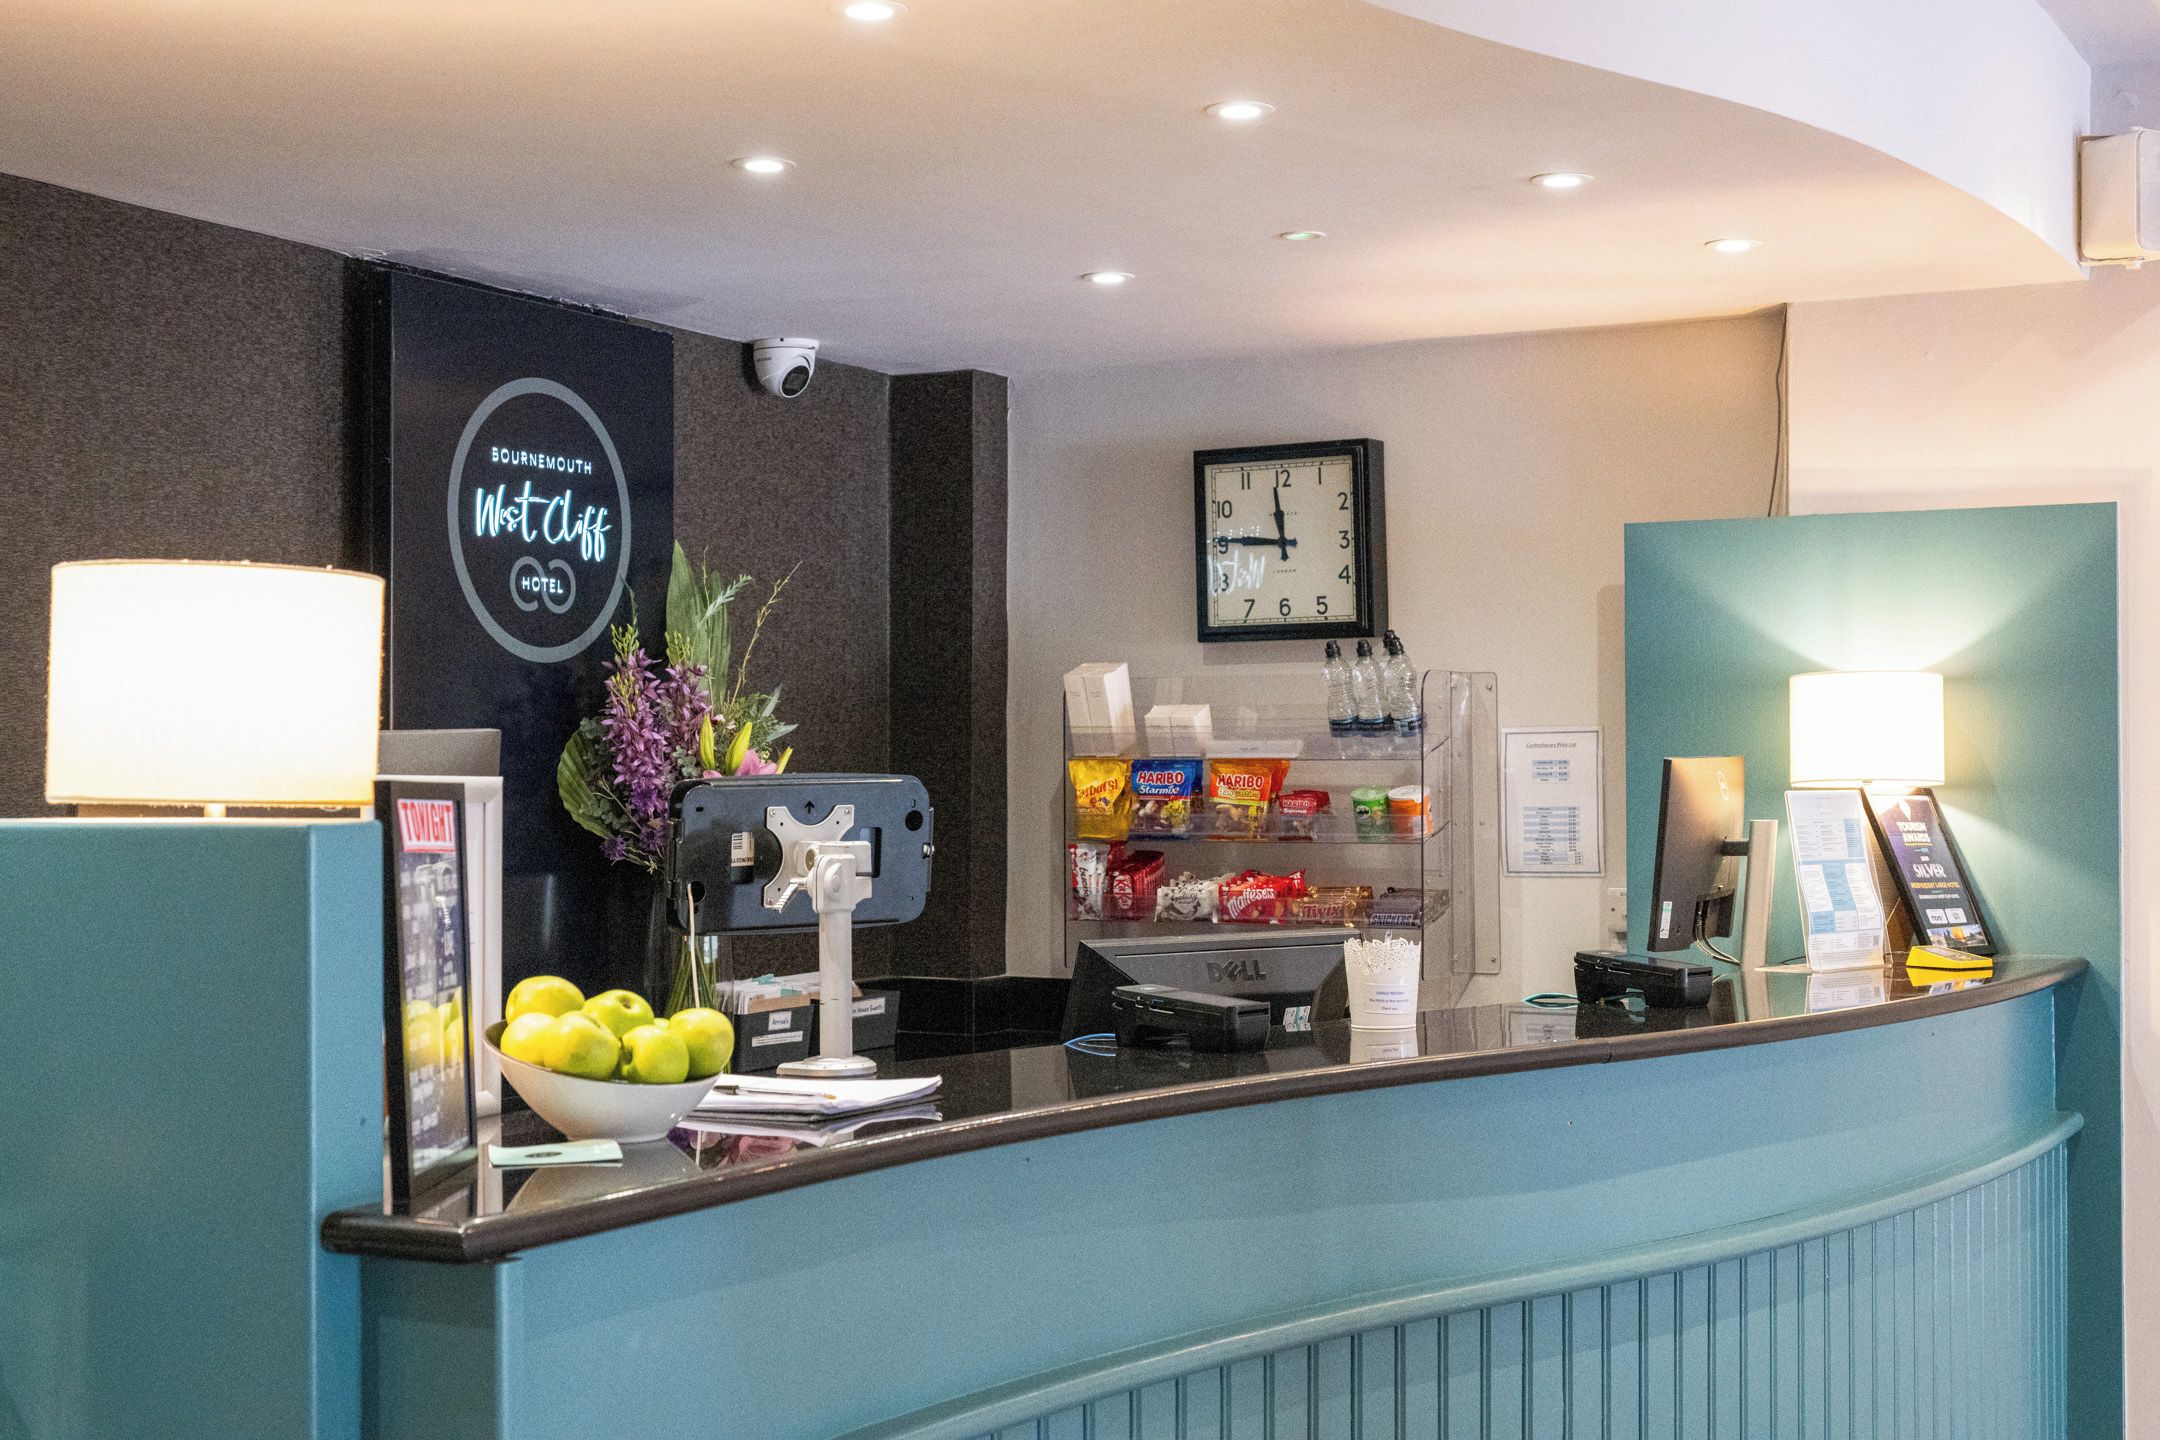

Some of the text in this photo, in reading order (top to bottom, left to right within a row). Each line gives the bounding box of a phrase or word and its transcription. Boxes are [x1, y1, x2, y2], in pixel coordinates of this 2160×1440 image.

[492, 447, 592, 475] BOURNEMOUTH
[1241, 472, 1252, 490] 11
[1274, 469, 1292, 488] 12
[1317, 467, 1322, 485] 1
[1217, 500, 1233, 518] 10
[1337, 492, 1349, 511] 2
[476, 480, 612, 562] West Cliff
[1217, 535, 1229, 555] 9
[1339, 530, 1351, 549] 3
[1338, 565, 1352, 584] 4
[521, 576, 564, 594] HOTEL
[1243, 599, 1256, 619] 7
[1279, 598, 1292, 617] 6
[1316, 596, 1329, 615] 5
[1136, 771, 1185, 786] HARIBO
[1216, 773, 1265, 789] HARIBO
[1138, 785, 1177, 795] Starmix
[1281, 798, 1312, 810] HARIBO
[402, 802, 452, 842] TONIGHT
[1903, 833, 1930, 842] AWARDS
[1912, 863, 1947, 878] SILVER
[1078, 867, 1090, 898] bueno
[1226, 888, 1276, 919] Maltesers
[1302, 903, 1344, 923] Twix
[1371, 914, 1414, 926] SNICKERS
[1207, 959, 1266, 983] DELL
